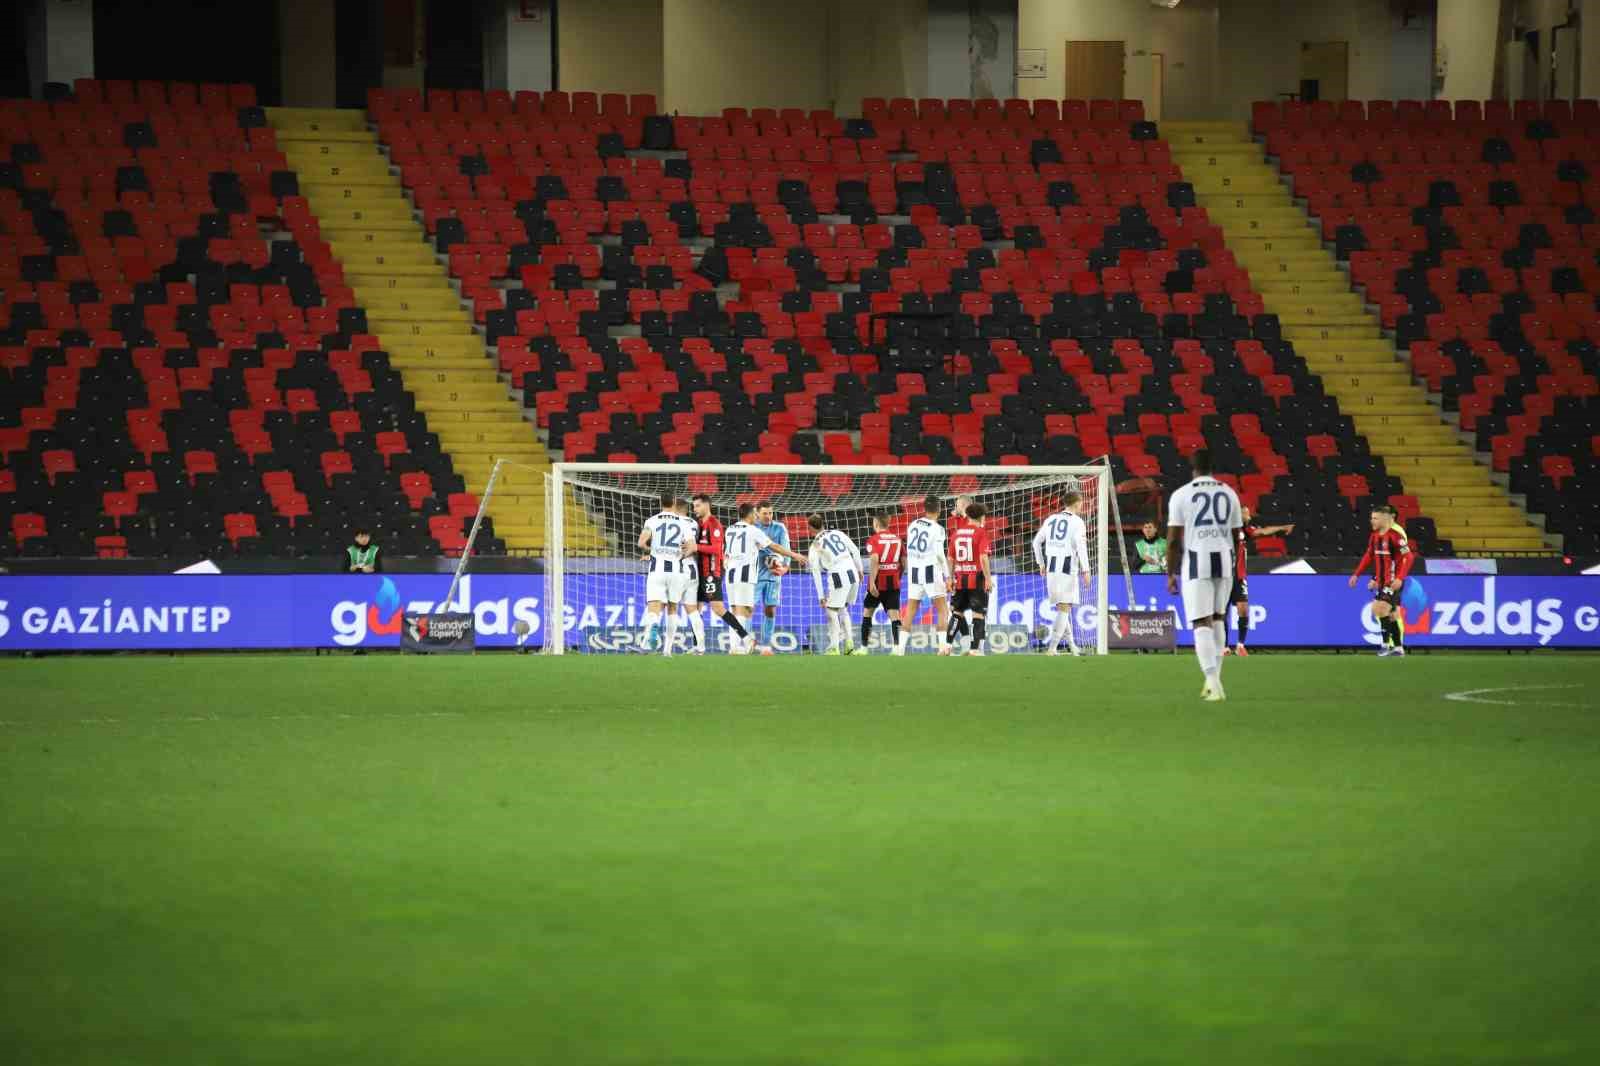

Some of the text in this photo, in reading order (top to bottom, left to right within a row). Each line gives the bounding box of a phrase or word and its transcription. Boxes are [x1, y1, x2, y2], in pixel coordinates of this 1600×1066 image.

[1191, 491, 1231, 526] 20
[655, 522, 682, 548] 12
[726, 531, 747, 553] 71
[908, 527, 928, 552] 26
[1047, 519, 1069, 541] 19
[822, 533, 846, 557] 18
[878, 539, 902, 563] 77
[955, 537, 974, 562] 61
[705, 583, 716, 594] 23
[22, 599, 231, 635] GAZİANTEP
